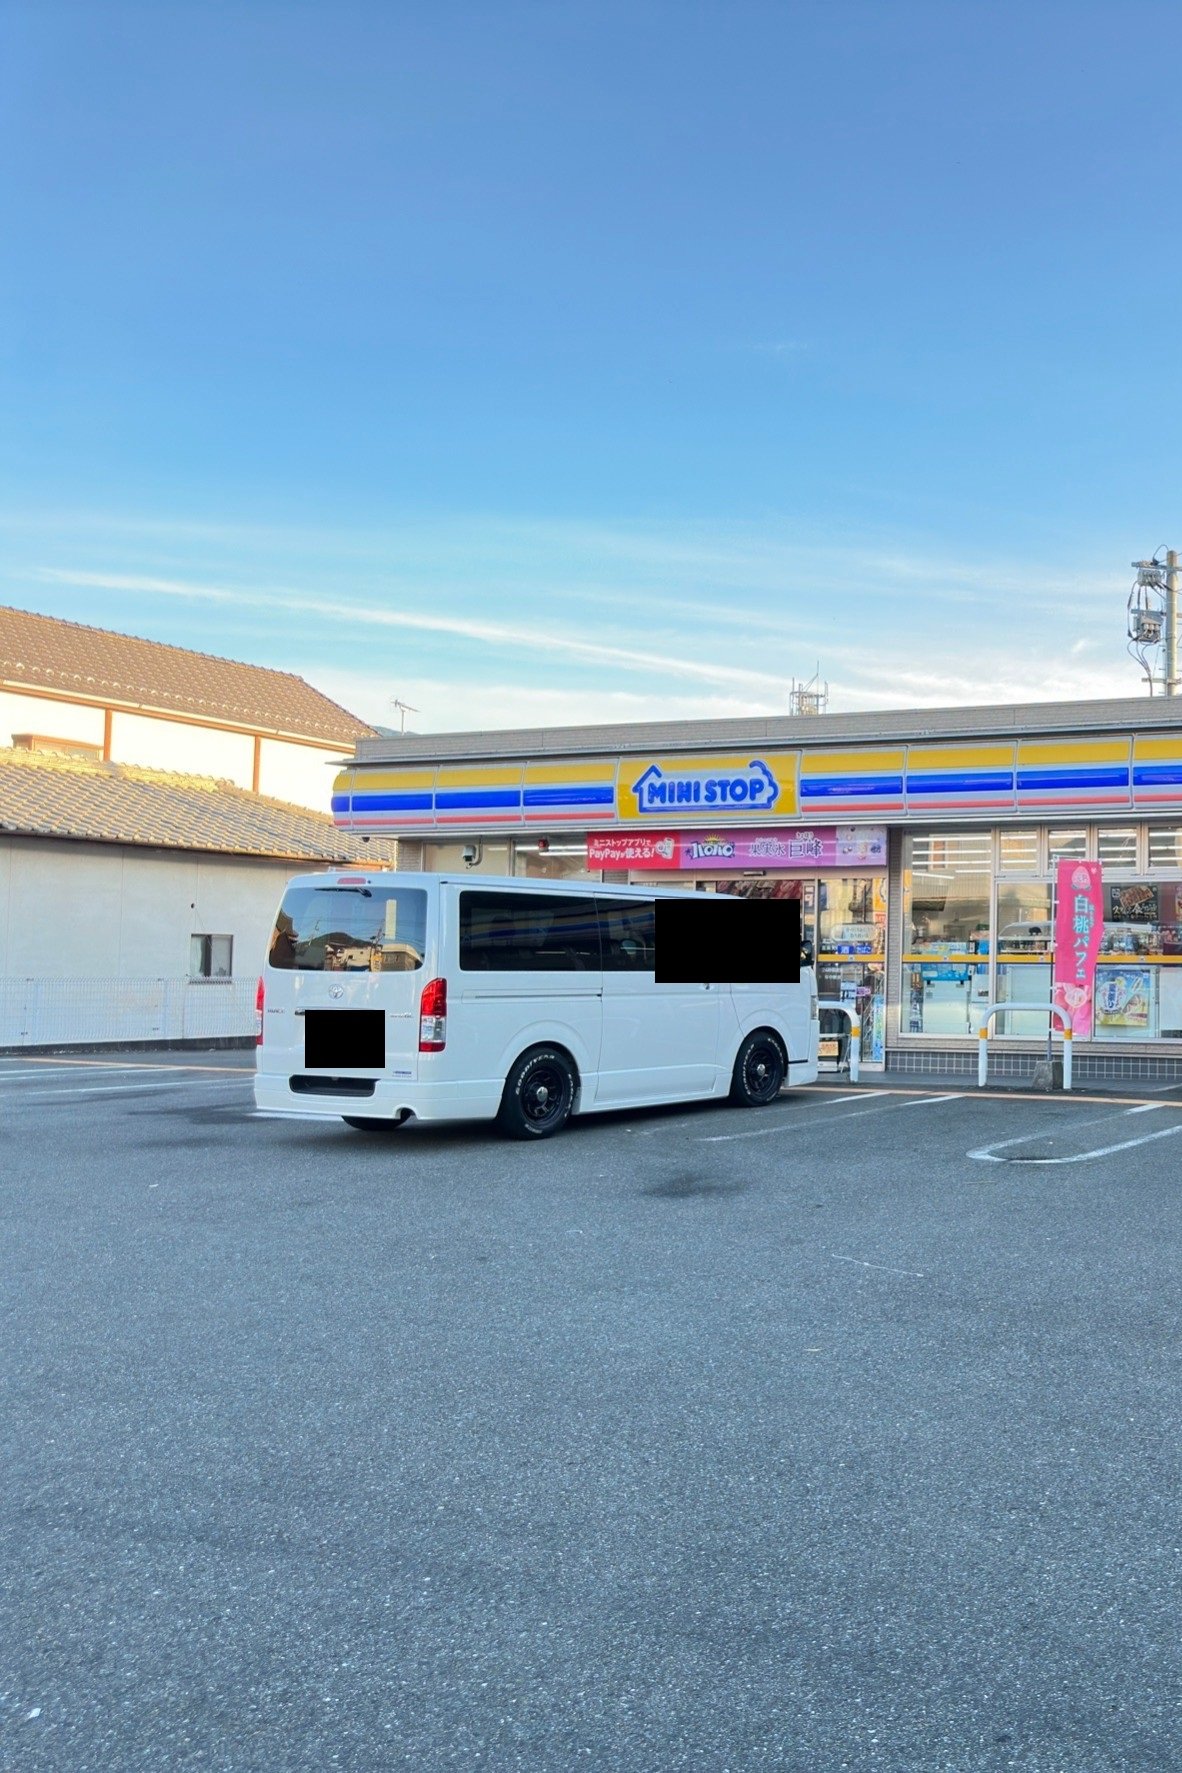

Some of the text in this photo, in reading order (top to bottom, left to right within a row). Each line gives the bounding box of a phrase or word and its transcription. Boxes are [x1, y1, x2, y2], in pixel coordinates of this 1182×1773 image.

[648, 778, 765, 804] MINI STOP
[593, 838, 652, 847] ミニストップアプリで
[788, 838, 823, 858] 巨峰
[1073, 894, 1090, 979] 白桃パフェ
